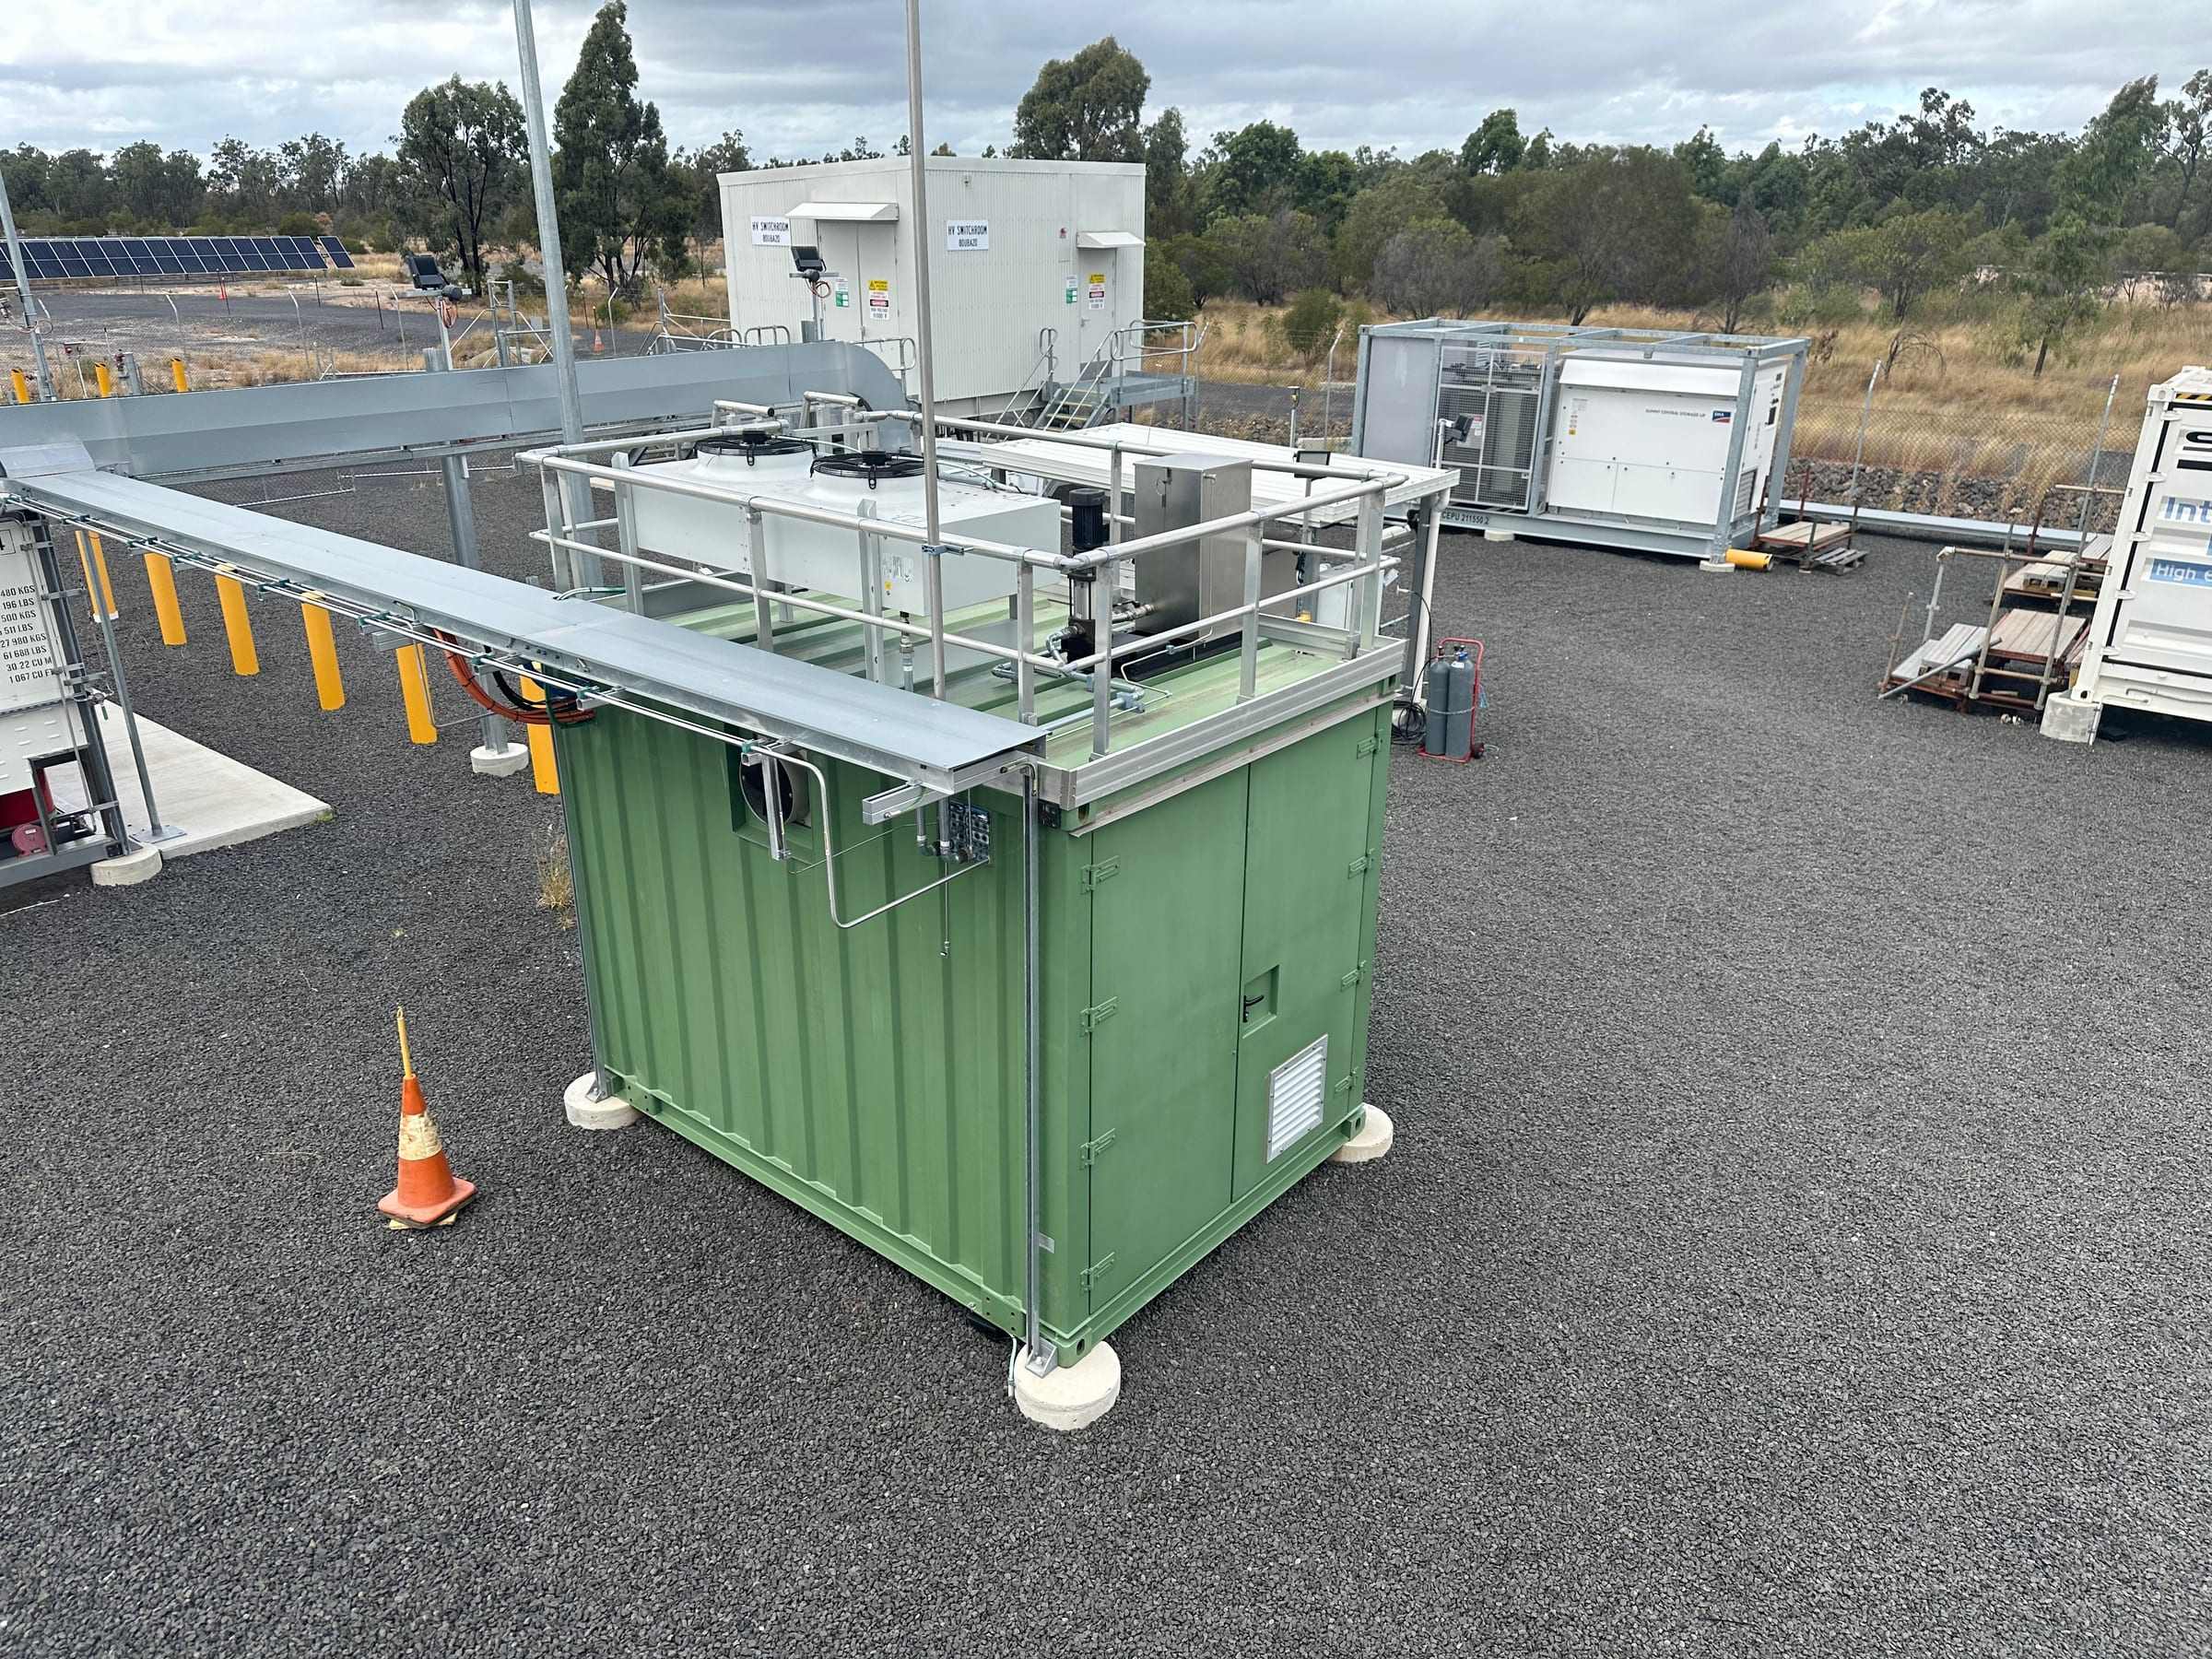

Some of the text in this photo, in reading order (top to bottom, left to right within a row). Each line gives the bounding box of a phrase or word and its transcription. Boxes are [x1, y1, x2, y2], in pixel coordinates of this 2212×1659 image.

[752, 221, 789, 231] HV SWITCHROOM
[948, 226, 987, 235] HV SWITCHROOM
[1441, 511, 1489, 524] CEPU 211550 2
[2155, 564, 2196, 582] High
[0, 584, 36, 597] 480 KGS
[2, 597, 35, 610] 196 LBS
[1, 609, 37, 623] 500 KGS
[4, 626, 17, 635] 511
[18, 623, 34, 633] LBS
[0, 632, 47, 648] 27 980 KGS
[3, 645, 47, 661] 61 688 LBS
[31, 658, 43, 667] CU
[44, 656, 53, 665] M
[15, 673, 30, 683] 067
[31, 671, 43, 680] CU
